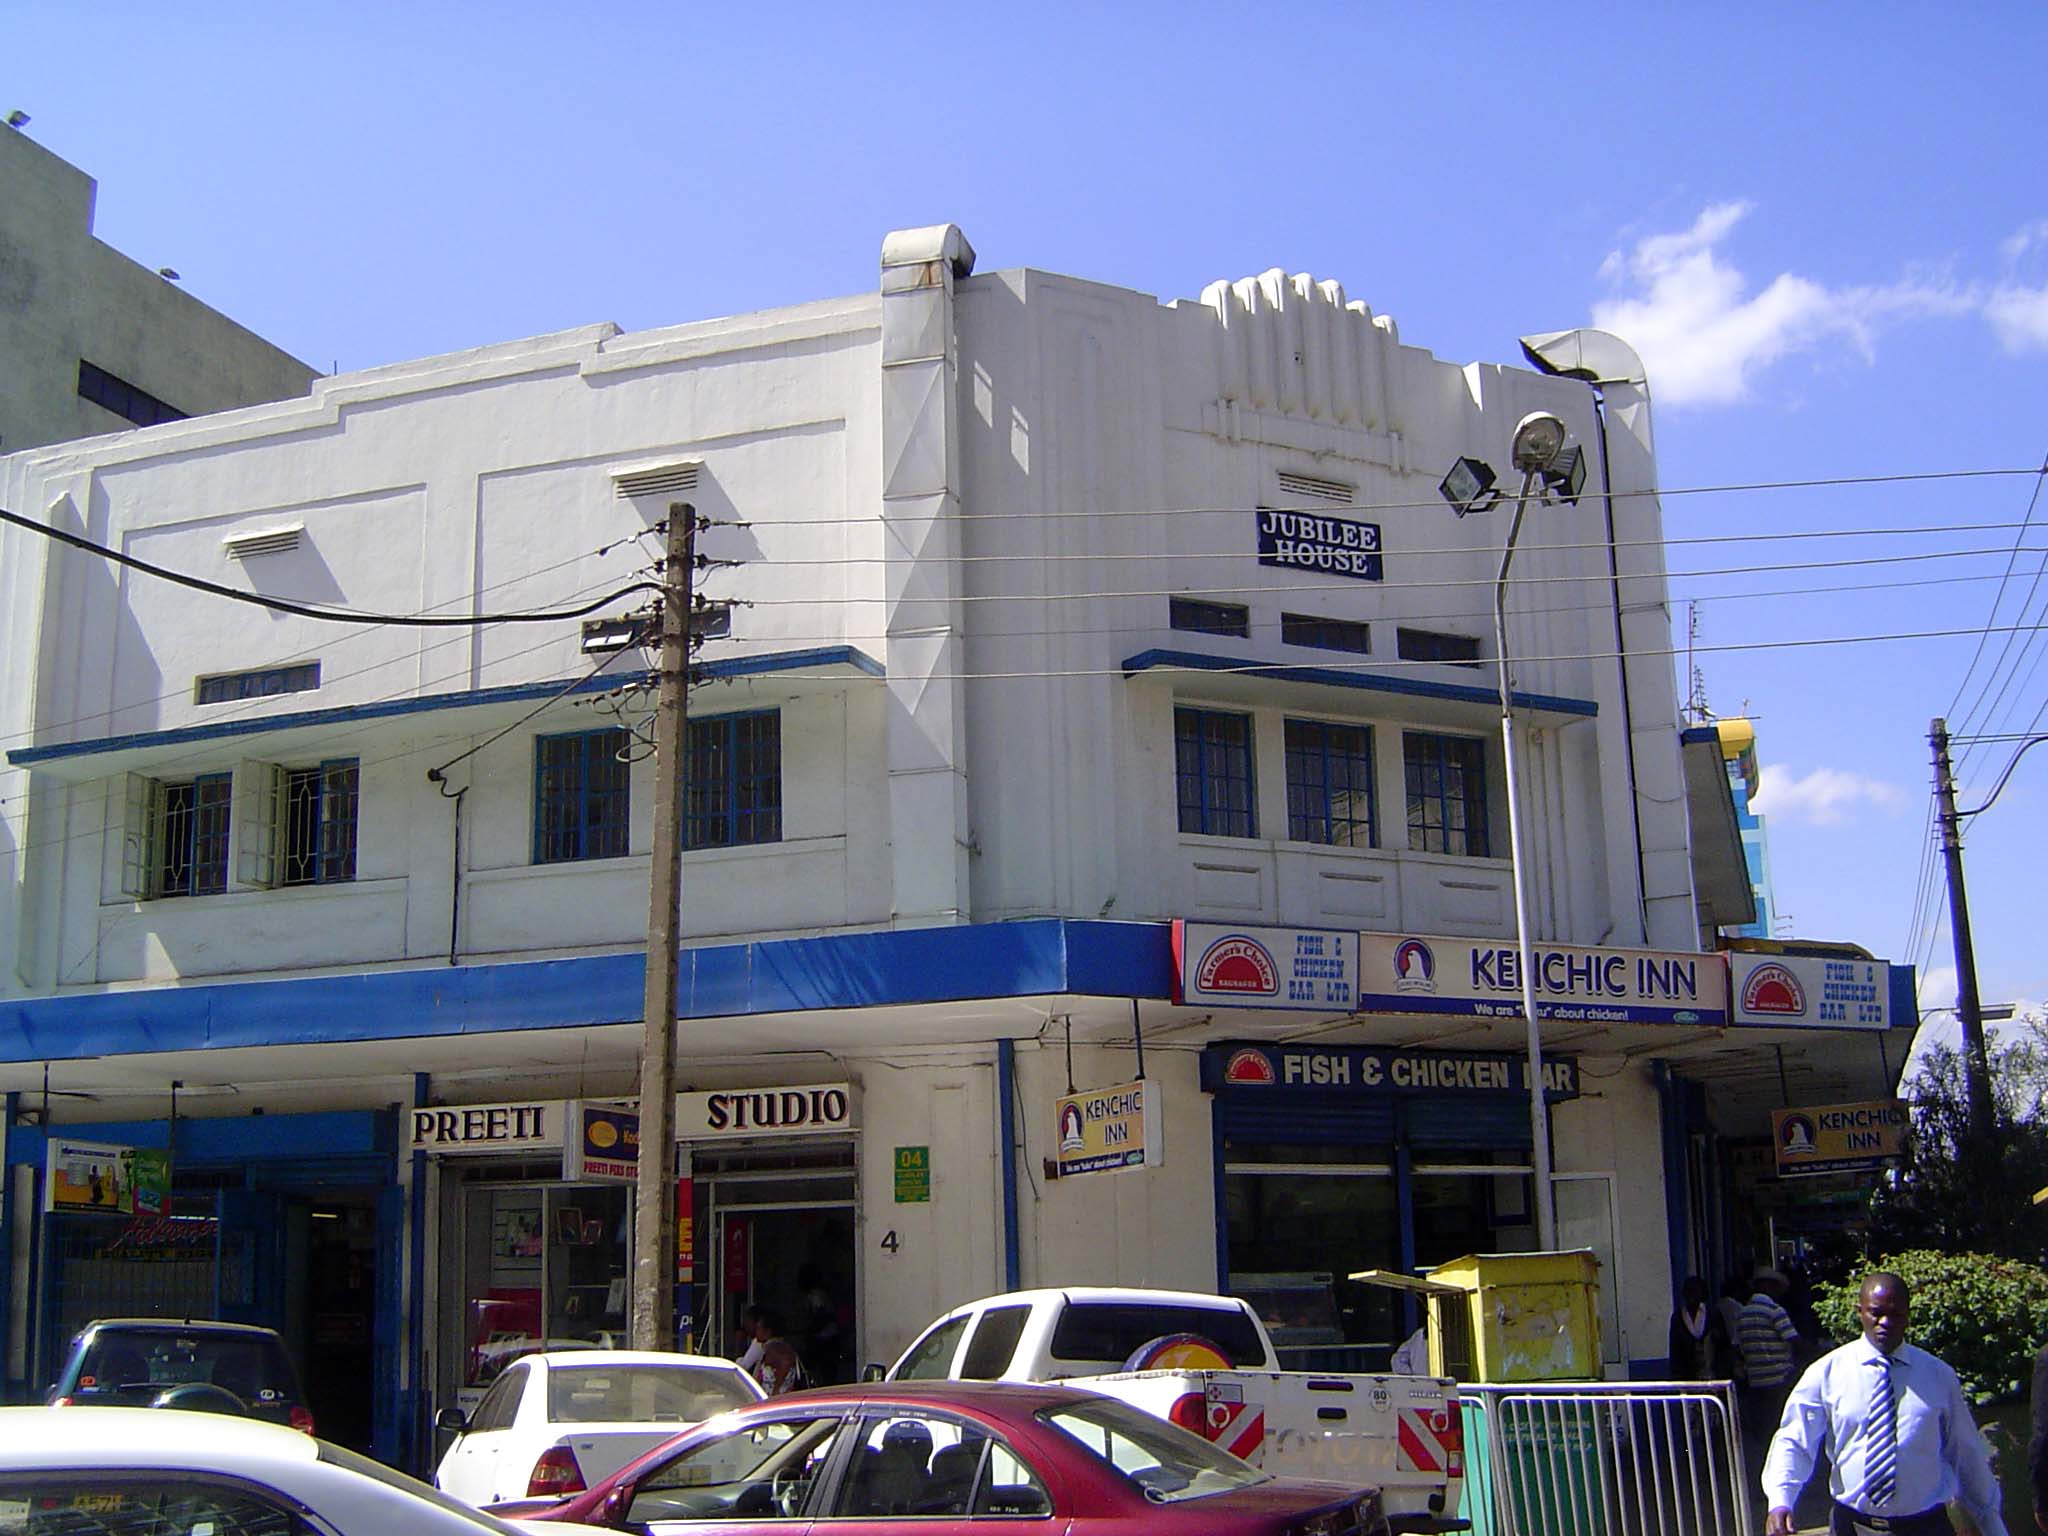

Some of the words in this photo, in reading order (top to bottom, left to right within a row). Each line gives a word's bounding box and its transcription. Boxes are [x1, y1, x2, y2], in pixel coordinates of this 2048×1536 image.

[1262, 512, 1377, 550] JUBILEE
[1275, 540, 1368, 574] HOUSE
[1296, 935, 1324, 956] FISH
[1202, 944, 1242, 984] Farmer's
[1293, 958, 1345, 979] CHICKEN
[1825, 963, 1855, 981] FISH
[1637, 957, 1698, 1000] INN
[1289, 980, 1315, 1000] BAR
[1327, 982, 1350, 1002] LTD
[1824, 983, 1877, 1002] CHICKEN
[1475, 1003, 1494, 1016] We
[1495, 1006, 1513, 1017] are
[1554, 1006, 1585, 1020] about
[1586, 1009, 1629, 1022] chicken!
[1819, 1003, 1847, 1021] BAR
[1858, 1005, 1882, 1022] LTD
[1284, 1055, 1351, 1085] FISH
[1362, 1056, 1384, 1086] &
[1391, 1057, 1510, 1089] CHICKEN
[1085, 1090, 1142, 1120] KENCHIC
[412, 1105, 545, 1145] PREETI
[707, 1089, 847, 1131] STUDIO
[1104, 1121, 1128, 1145] INN
[1847, 1131, 1881, 1150] INN
[901, 1151, 922, 1168] 04
[881, 1230, 900, 1253] 4
